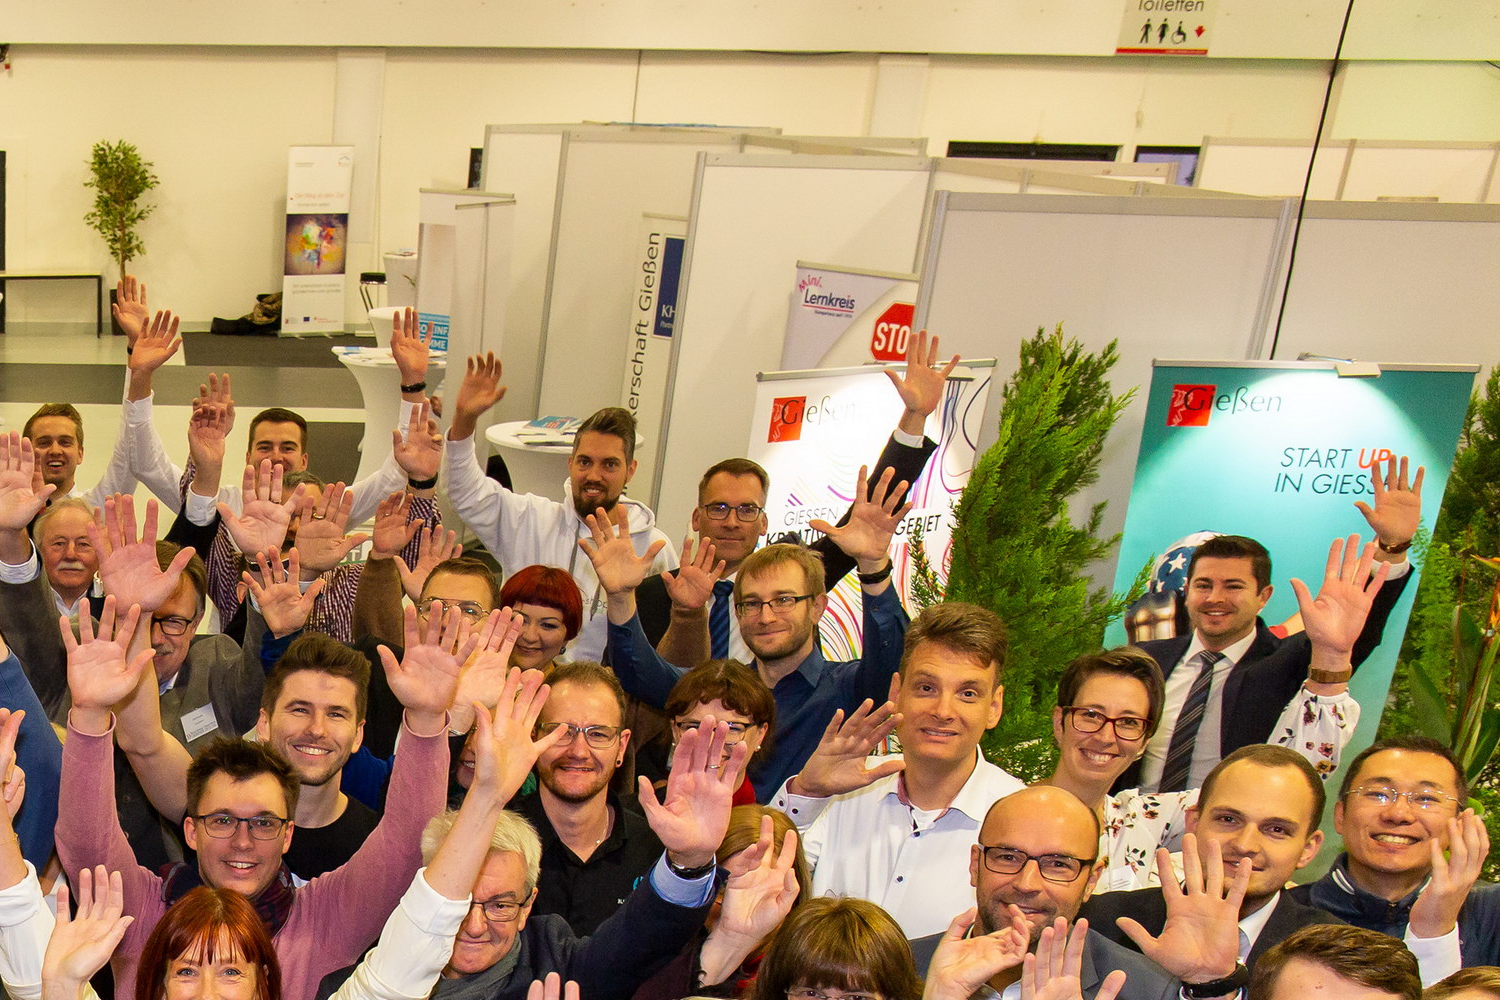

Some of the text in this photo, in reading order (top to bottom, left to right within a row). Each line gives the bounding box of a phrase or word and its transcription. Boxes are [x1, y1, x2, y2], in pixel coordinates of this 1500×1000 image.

[804, 288, 855, 310] Lernkreis
[628, 232, 660, 416] erschaft Gießen
[874, 322, 910, 354] STO
[1184, 386, 1282, 414] Gießen
[1280, 447, 1393, 469] START UP
[1274, 473, 1380, 495] IN GIESS
[784, 507, 839, 526] GIESSEN
[894, 514, 942, 536] GEBIET
